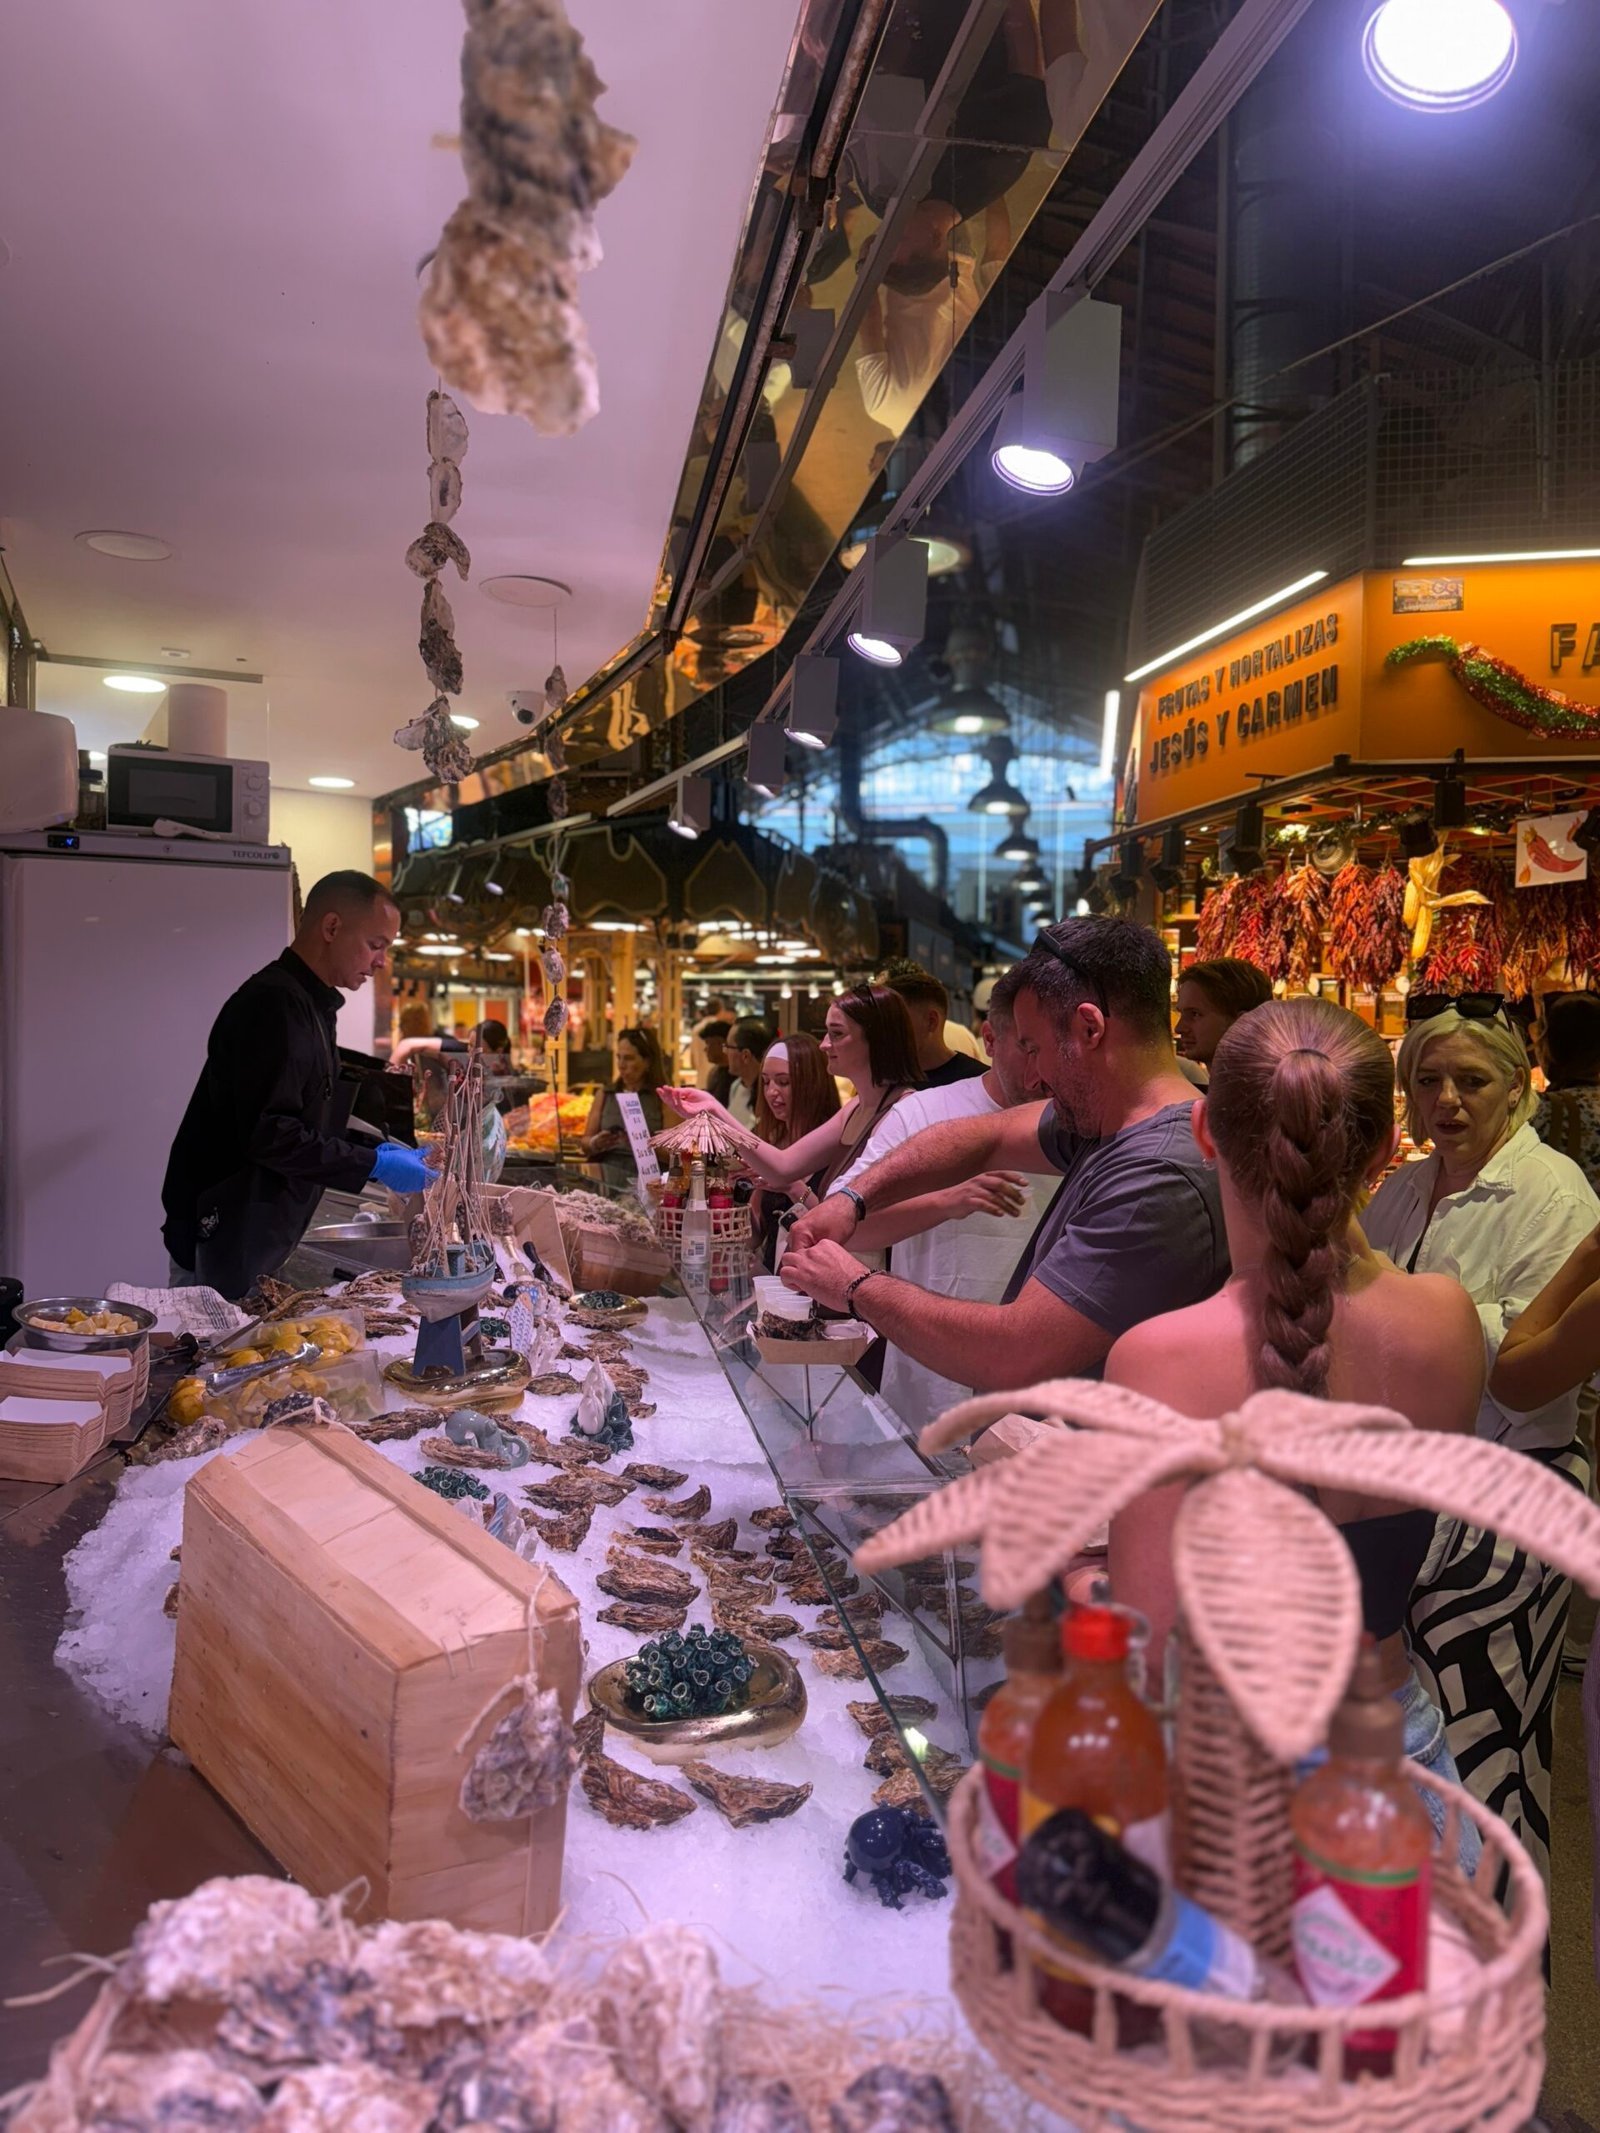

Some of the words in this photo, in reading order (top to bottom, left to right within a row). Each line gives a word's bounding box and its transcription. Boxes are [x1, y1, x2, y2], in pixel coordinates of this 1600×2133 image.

[1150, 717, 1208, 773] JESÚS
[1216, 710, 1230, 747] Y
[1237, 664, 1338, 738] CARMEN
[1158, 675, 1210, 721] FRUTAS
[1215, 666, 1225, 694] Y
[1230, 613, 1338, 688] HORTALIZAS
